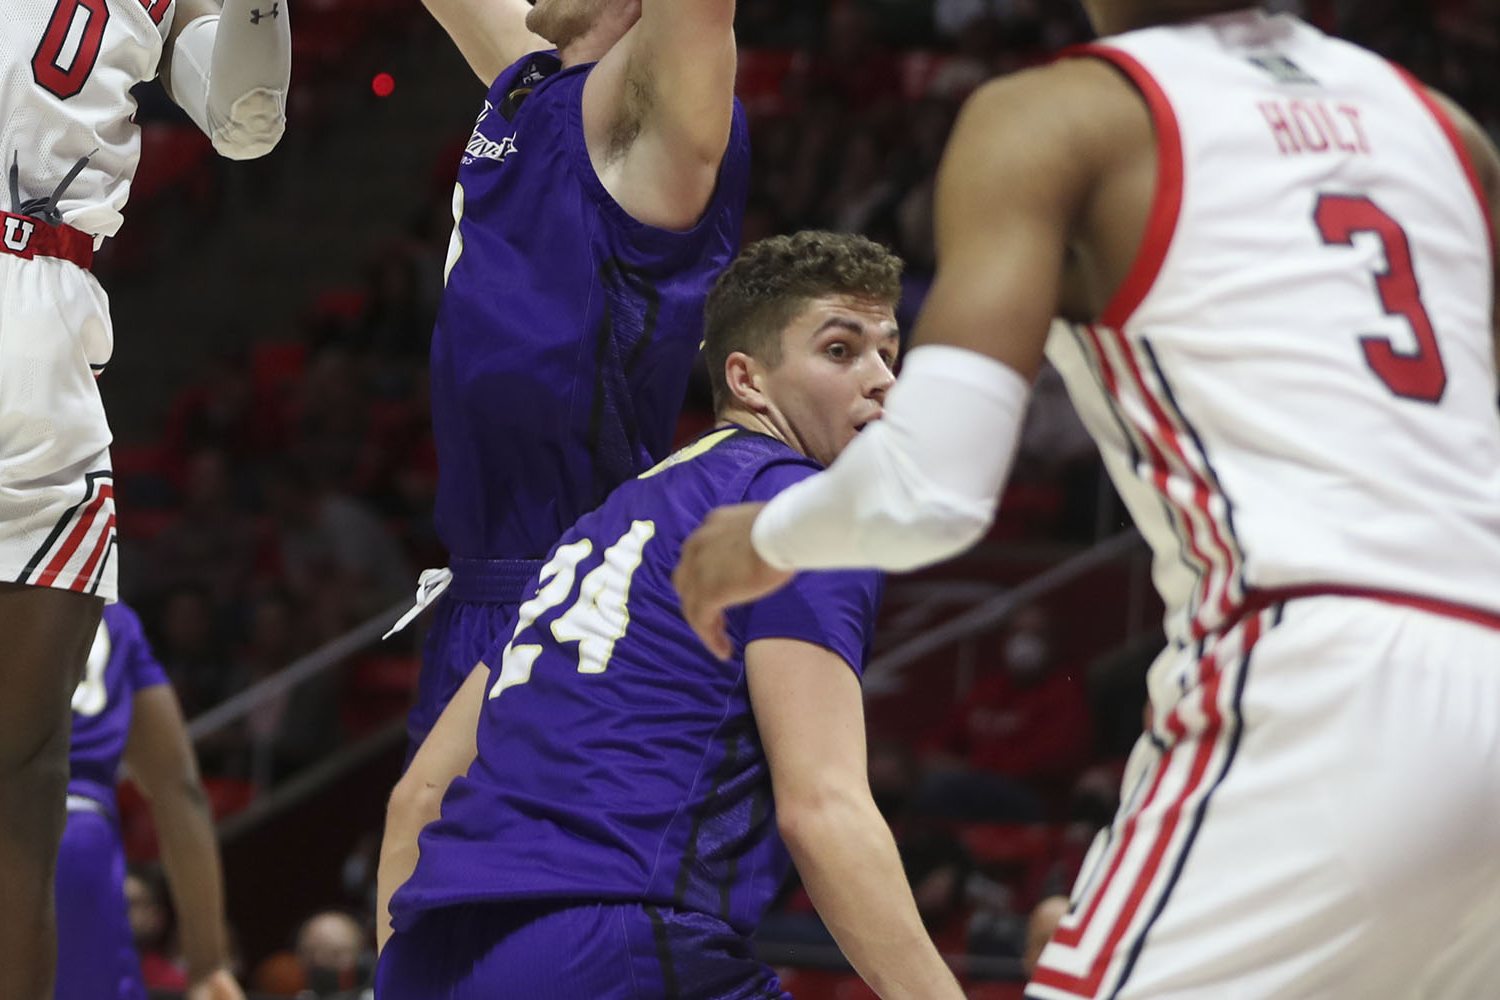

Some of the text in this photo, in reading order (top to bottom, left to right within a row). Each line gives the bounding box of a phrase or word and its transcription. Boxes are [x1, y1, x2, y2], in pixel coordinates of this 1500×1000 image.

[1256, 99, 1371, 155] HOLT
[4, 216, 35, 252] U
[1313, 192, 1447, 405] 3
[489, 519, 655, 701] 24
